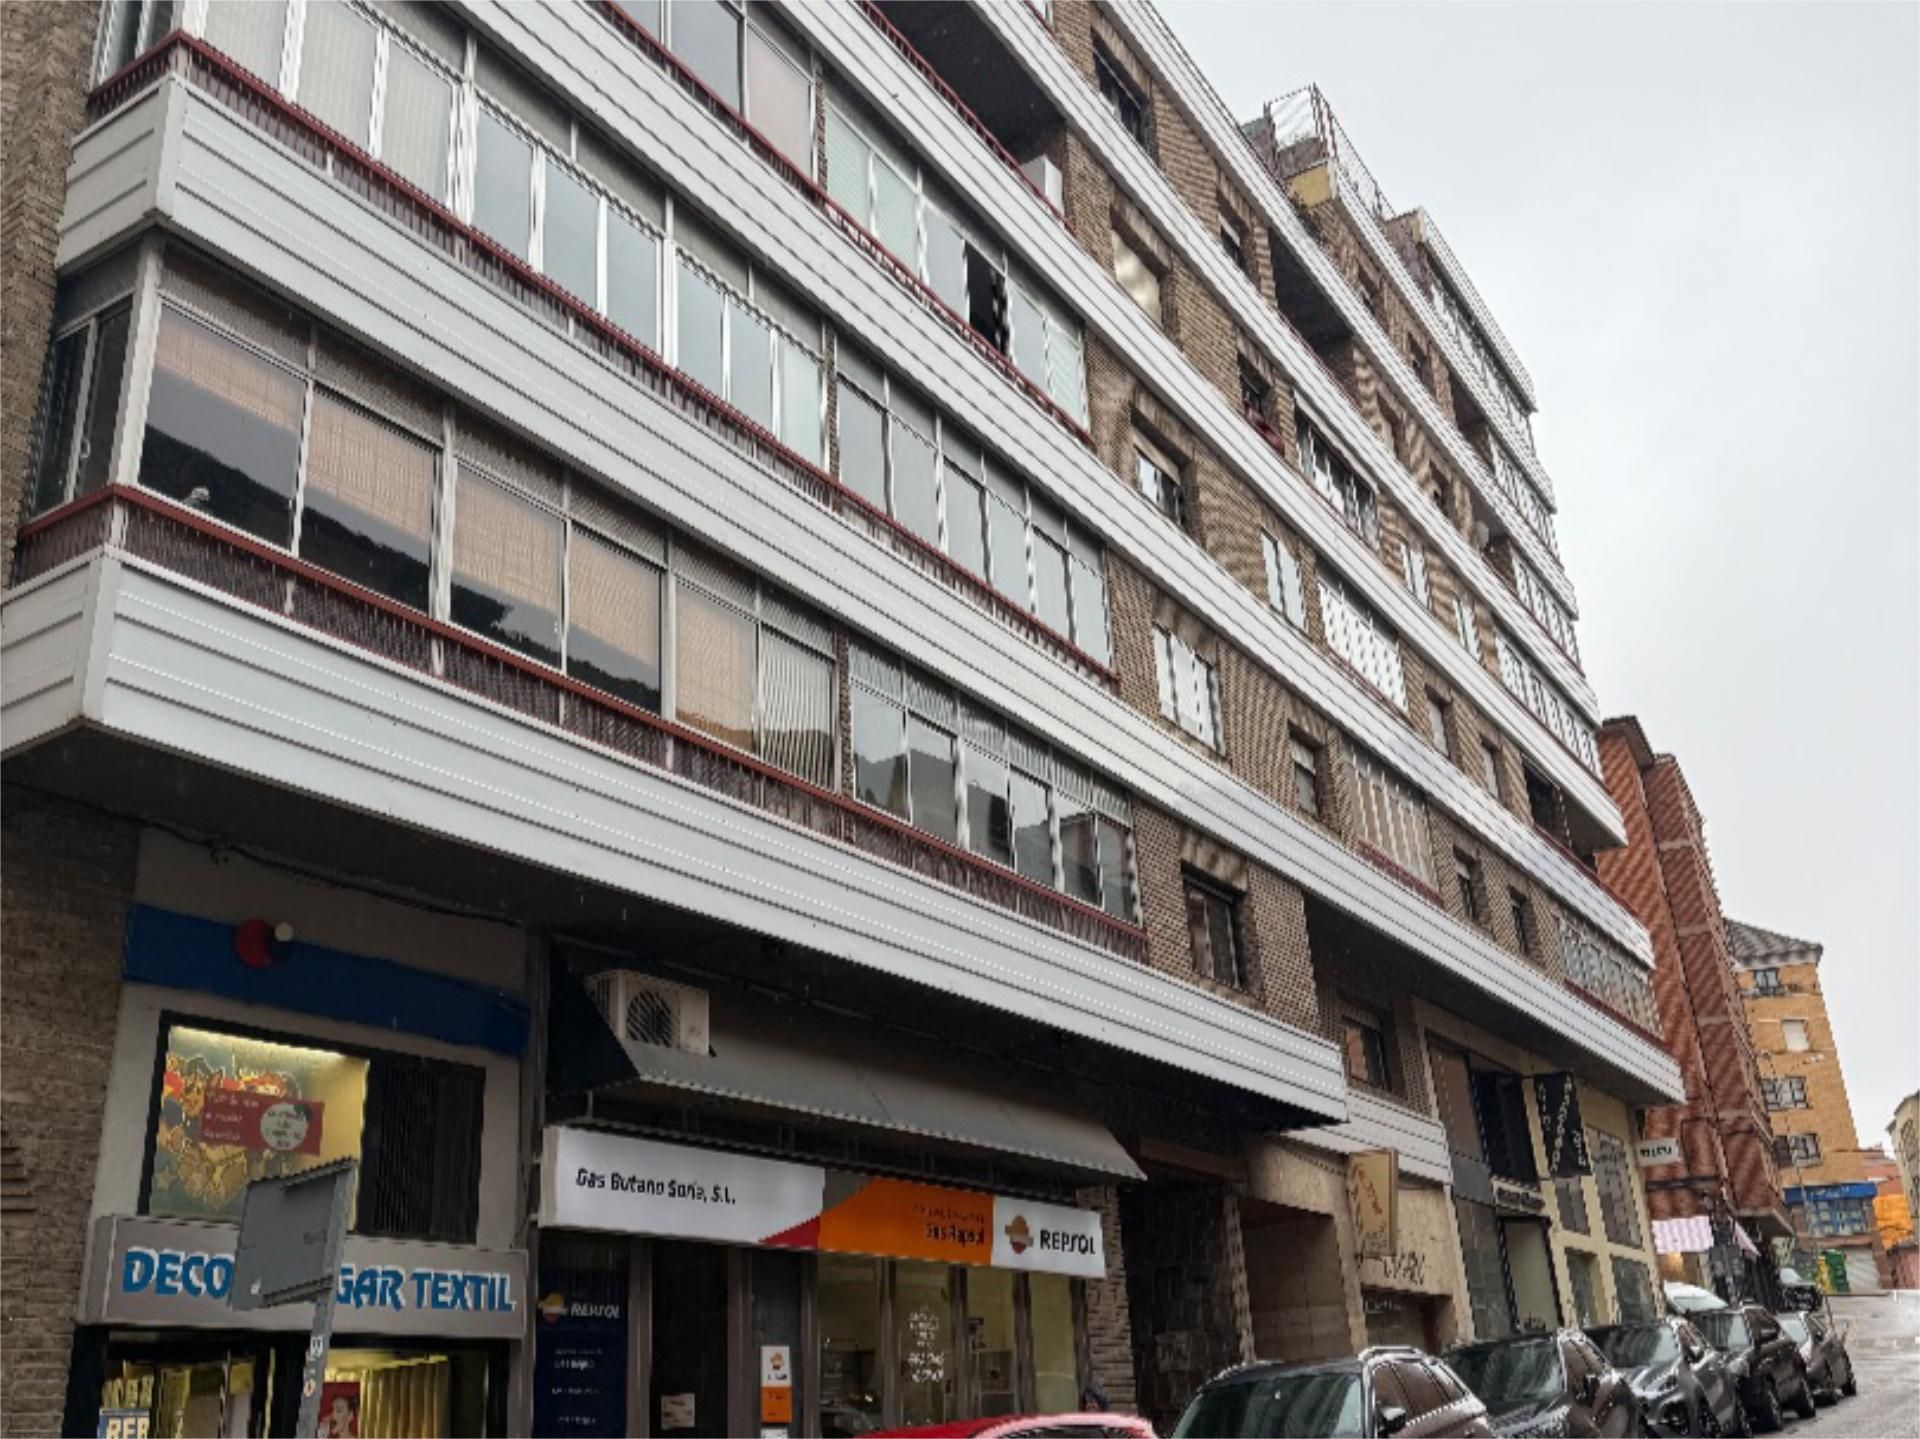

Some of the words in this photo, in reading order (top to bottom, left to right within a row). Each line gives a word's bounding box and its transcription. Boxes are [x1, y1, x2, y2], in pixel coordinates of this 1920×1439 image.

[577, 1168, 605, 1188] Gas
[611, 1173, 664, 1195] Butano
[1039, 1230, 1096, 1255] REPSOL
[122, 1248, 236, 1299] DECO
[410, 1269, 517, 1312] TEXTIL
